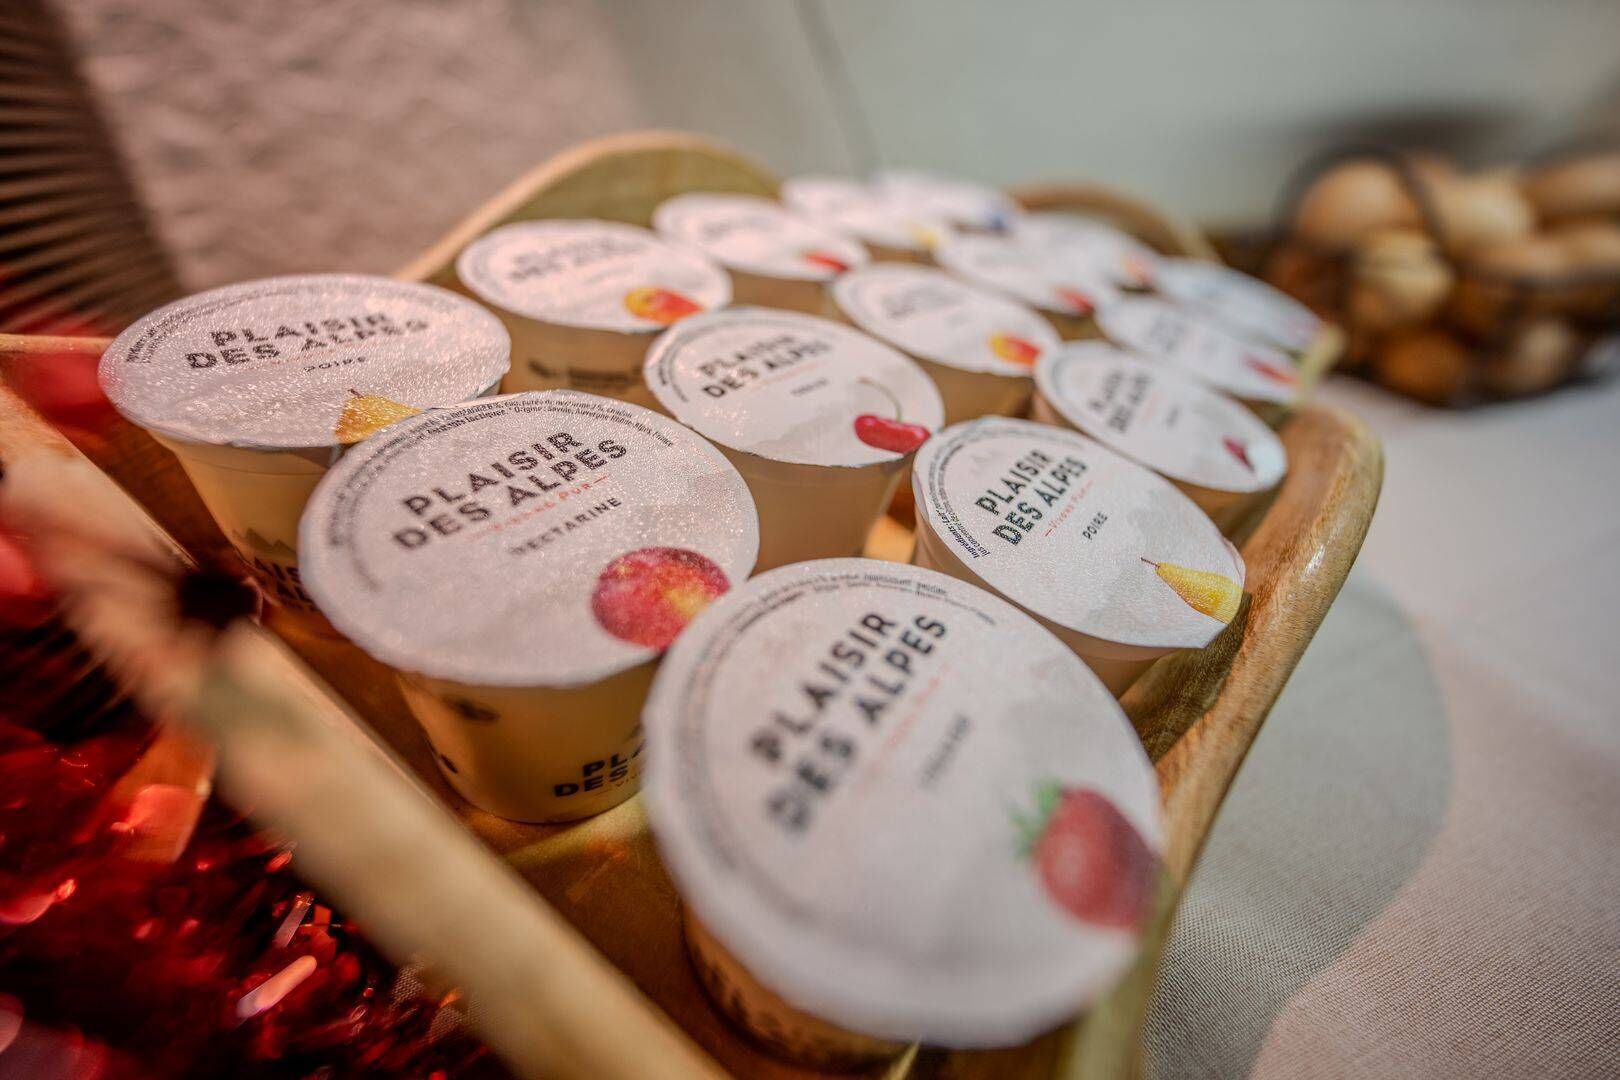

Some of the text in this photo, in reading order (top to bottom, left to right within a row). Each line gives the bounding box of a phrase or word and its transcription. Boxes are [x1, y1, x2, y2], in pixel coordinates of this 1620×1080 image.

[185, 342, 279, 369] DES
[300, 319, 428, 351] ALPES
[211, 312, 388, 346] PLAISIR
[393, 502, 491, 550] DES
[510, 438, 628, 506] ALPES
[404, 431, 581, 516] PLAISIR
[975, 450, 1052, 515] PLAISIR
[992, 456, 1088, 546] DES ALPES
[512, 497, 622, 555] NECTARINE
[1082, 510, 1108, 541] POIRE
[750, 611, 897, 764] PLAISIR
[766, 732, 858, 834] DES
[856, 613, 947, 727] ALPES
[554, 765, 628, 797] DES
